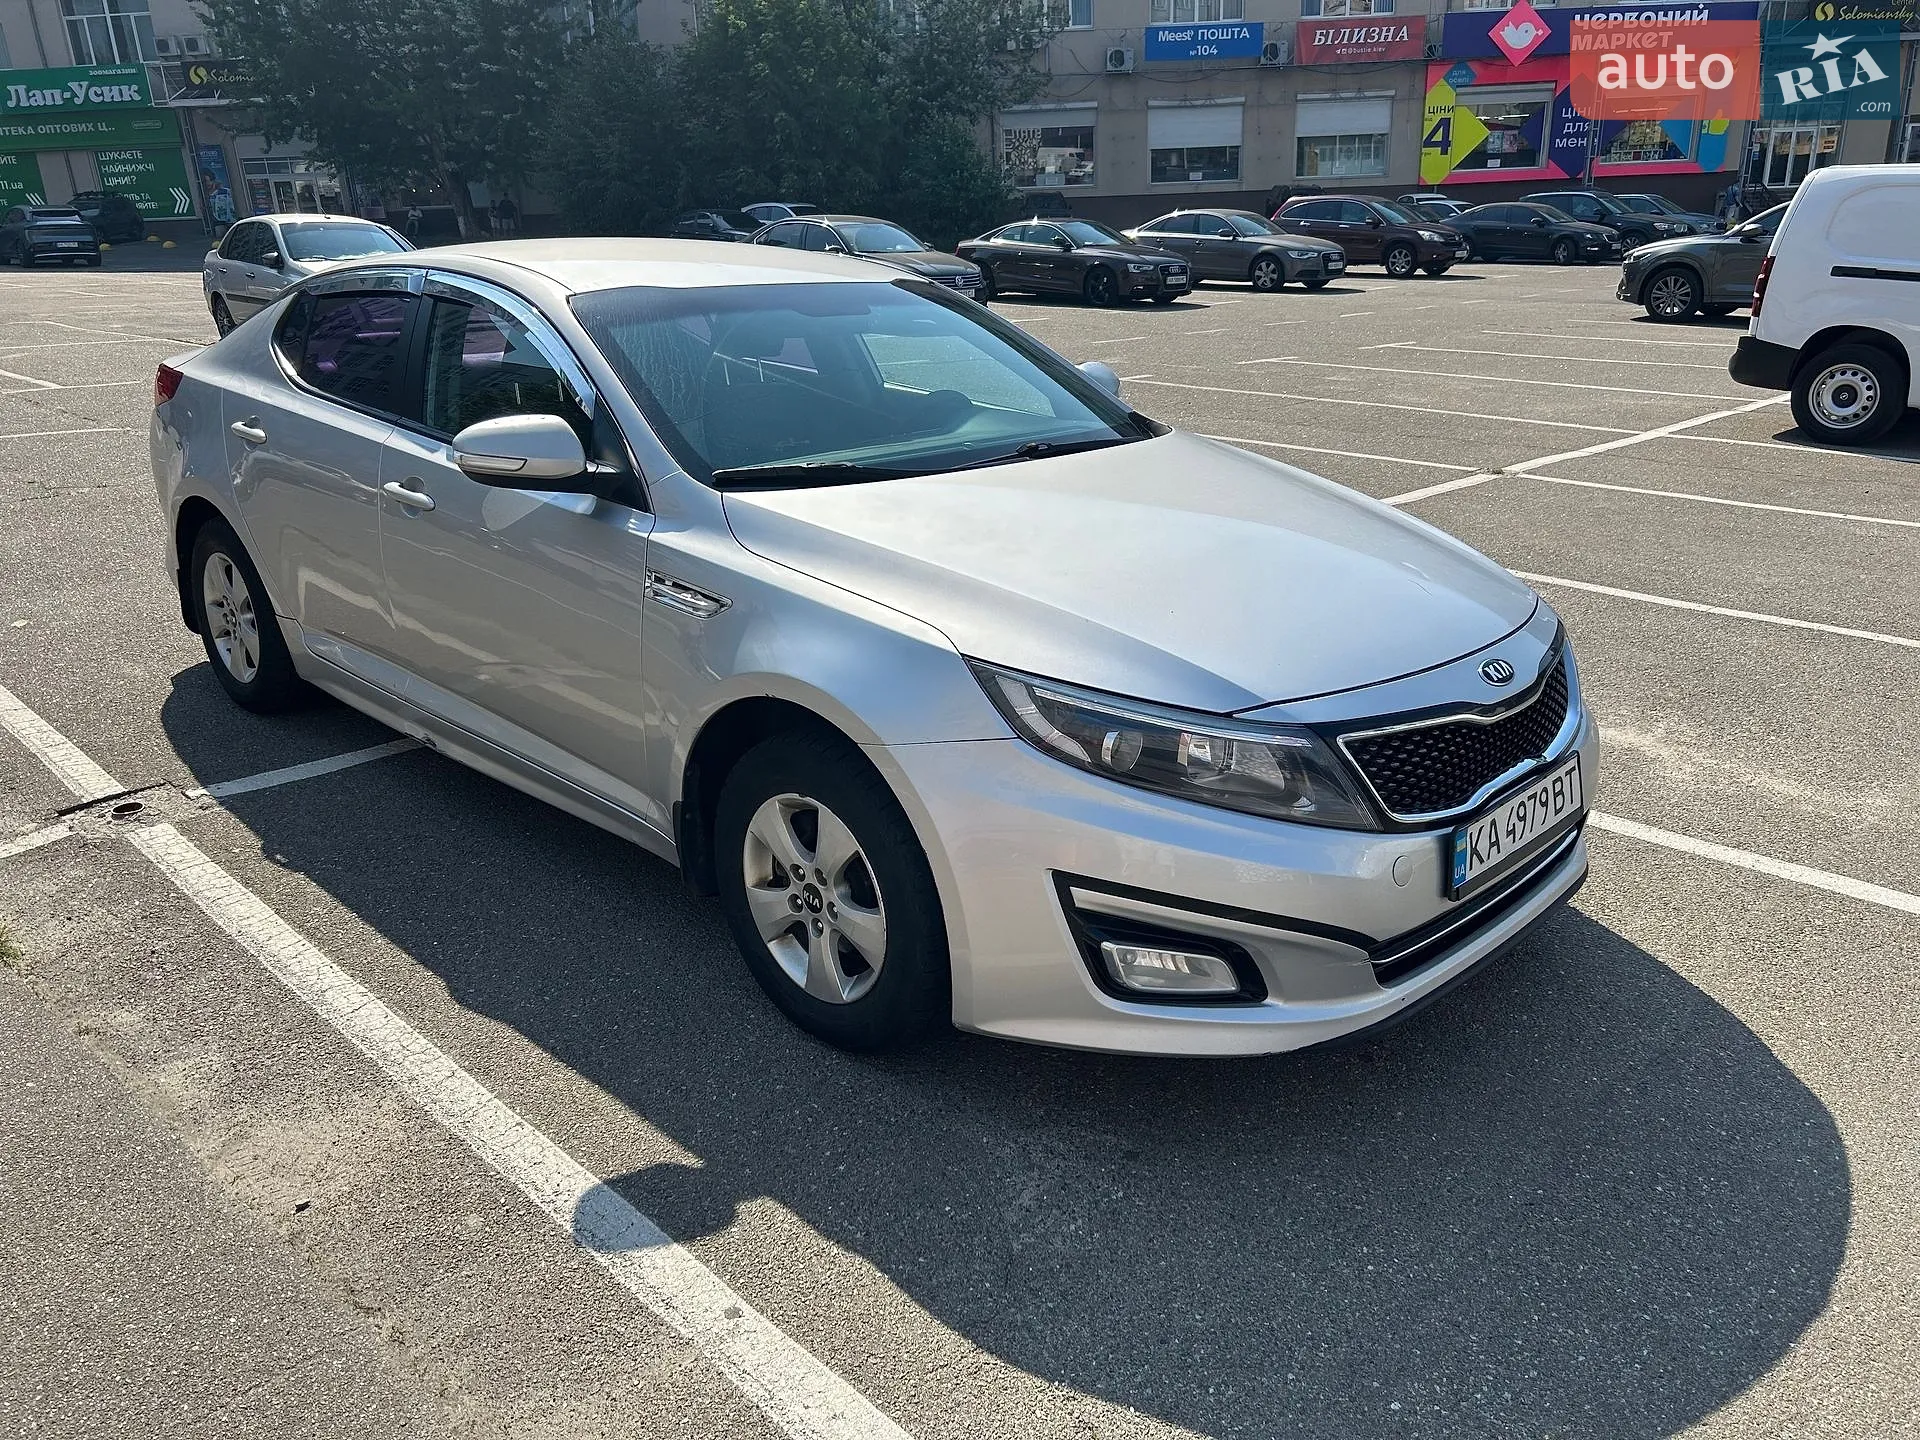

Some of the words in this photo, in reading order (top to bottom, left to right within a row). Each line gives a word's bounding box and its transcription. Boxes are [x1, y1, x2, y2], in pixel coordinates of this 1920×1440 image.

[1574, 3, 1709, 30] ЧЕРВОНИЙ
[1838, 5, 1914, 25] Solomiansky
[1158, 29, 1193, 42] Meest
[1198, 27, 1250, 41] ПОШТА
[1312, 25, 1409, 46] БІЛИЗНА
[1571, 31, 1674, 51] МАРКЕТ
[1189, 45, 1218, 56] №104
[6, 81, 142, 108] Лап-Усик
[0, 126, 35, 137] ТЕКА
[37, 122, 95, 134] ОПТОВИХ
[1422, 117, 1452, 156] 4
[1555, 137, 1597, 148] мен
[98, 150, 143, 161] ШУКАЄТЕ
[101, 162, 155, 174] НАЙНИЖЧІ
[1483, 660, 1513, 682] KIA
[1469, 817, 1501, 872] KA
[1505, 786, 1549, 844] 4979
[1552, 765, 1577, 816] BT
[1454, 865, 1466, 879] UA
[803, 889, 821, 909] KIA
